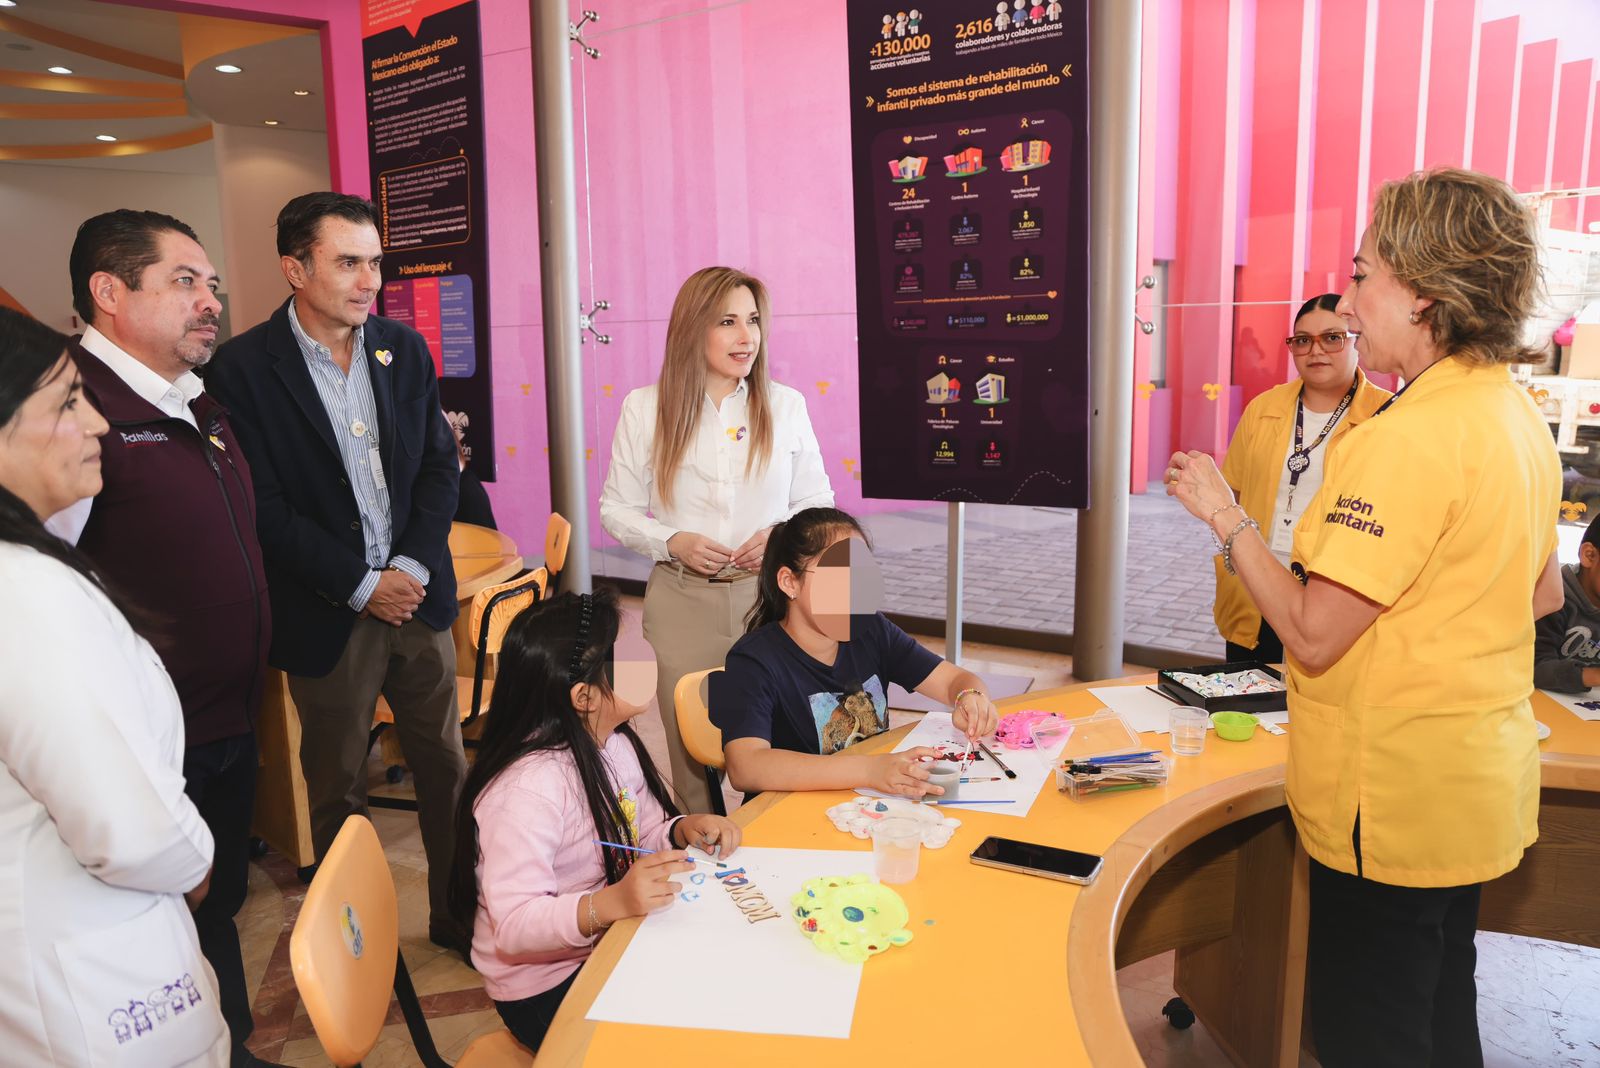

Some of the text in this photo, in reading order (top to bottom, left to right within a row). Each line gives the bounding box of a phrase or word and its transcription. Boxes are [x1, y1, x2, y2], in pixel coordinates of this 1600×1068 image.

[956, 18, 993, 38] 2,616
[956, 22, 1063, 48] colaboradores y colaboradoras
[399, 44, 432, 62] Convención
[432, 40, 437, 52] el
[437, 34, 458, 50] Estado
[870, 34, 930, 56] +130,000
[372, 68, 396, 82] Mexicano
[398, 62, 408, 74] está
[408, 56, 433, 71] obligado
[870, 54, 931, 70] acciones voluntarias
[886, 62, 1048, 98] Somos el sistema de rehabilitación
[877, 74, 1060, 112] infantil privado más grande del mundo
[962, 182, 968, 192] 1
[1022, 174, 1028, 186] 1
[902, 188, 916, 200] 24
[380, 177, 388, 247] Discapacidad
[404, 261, 446, 274] Uso del lenguaje
[1016, 314, 1048, 322] $1,000,000
[940, 407, 946, 418] 1
[988, 407, 994, 418] 1
[1321, 394, 1352, 436] Voluntariado
[120, 430, 168, 444] Familias
[1334, 494, 1374, 516] Acción
[725, 881, 782, 924] MOM
